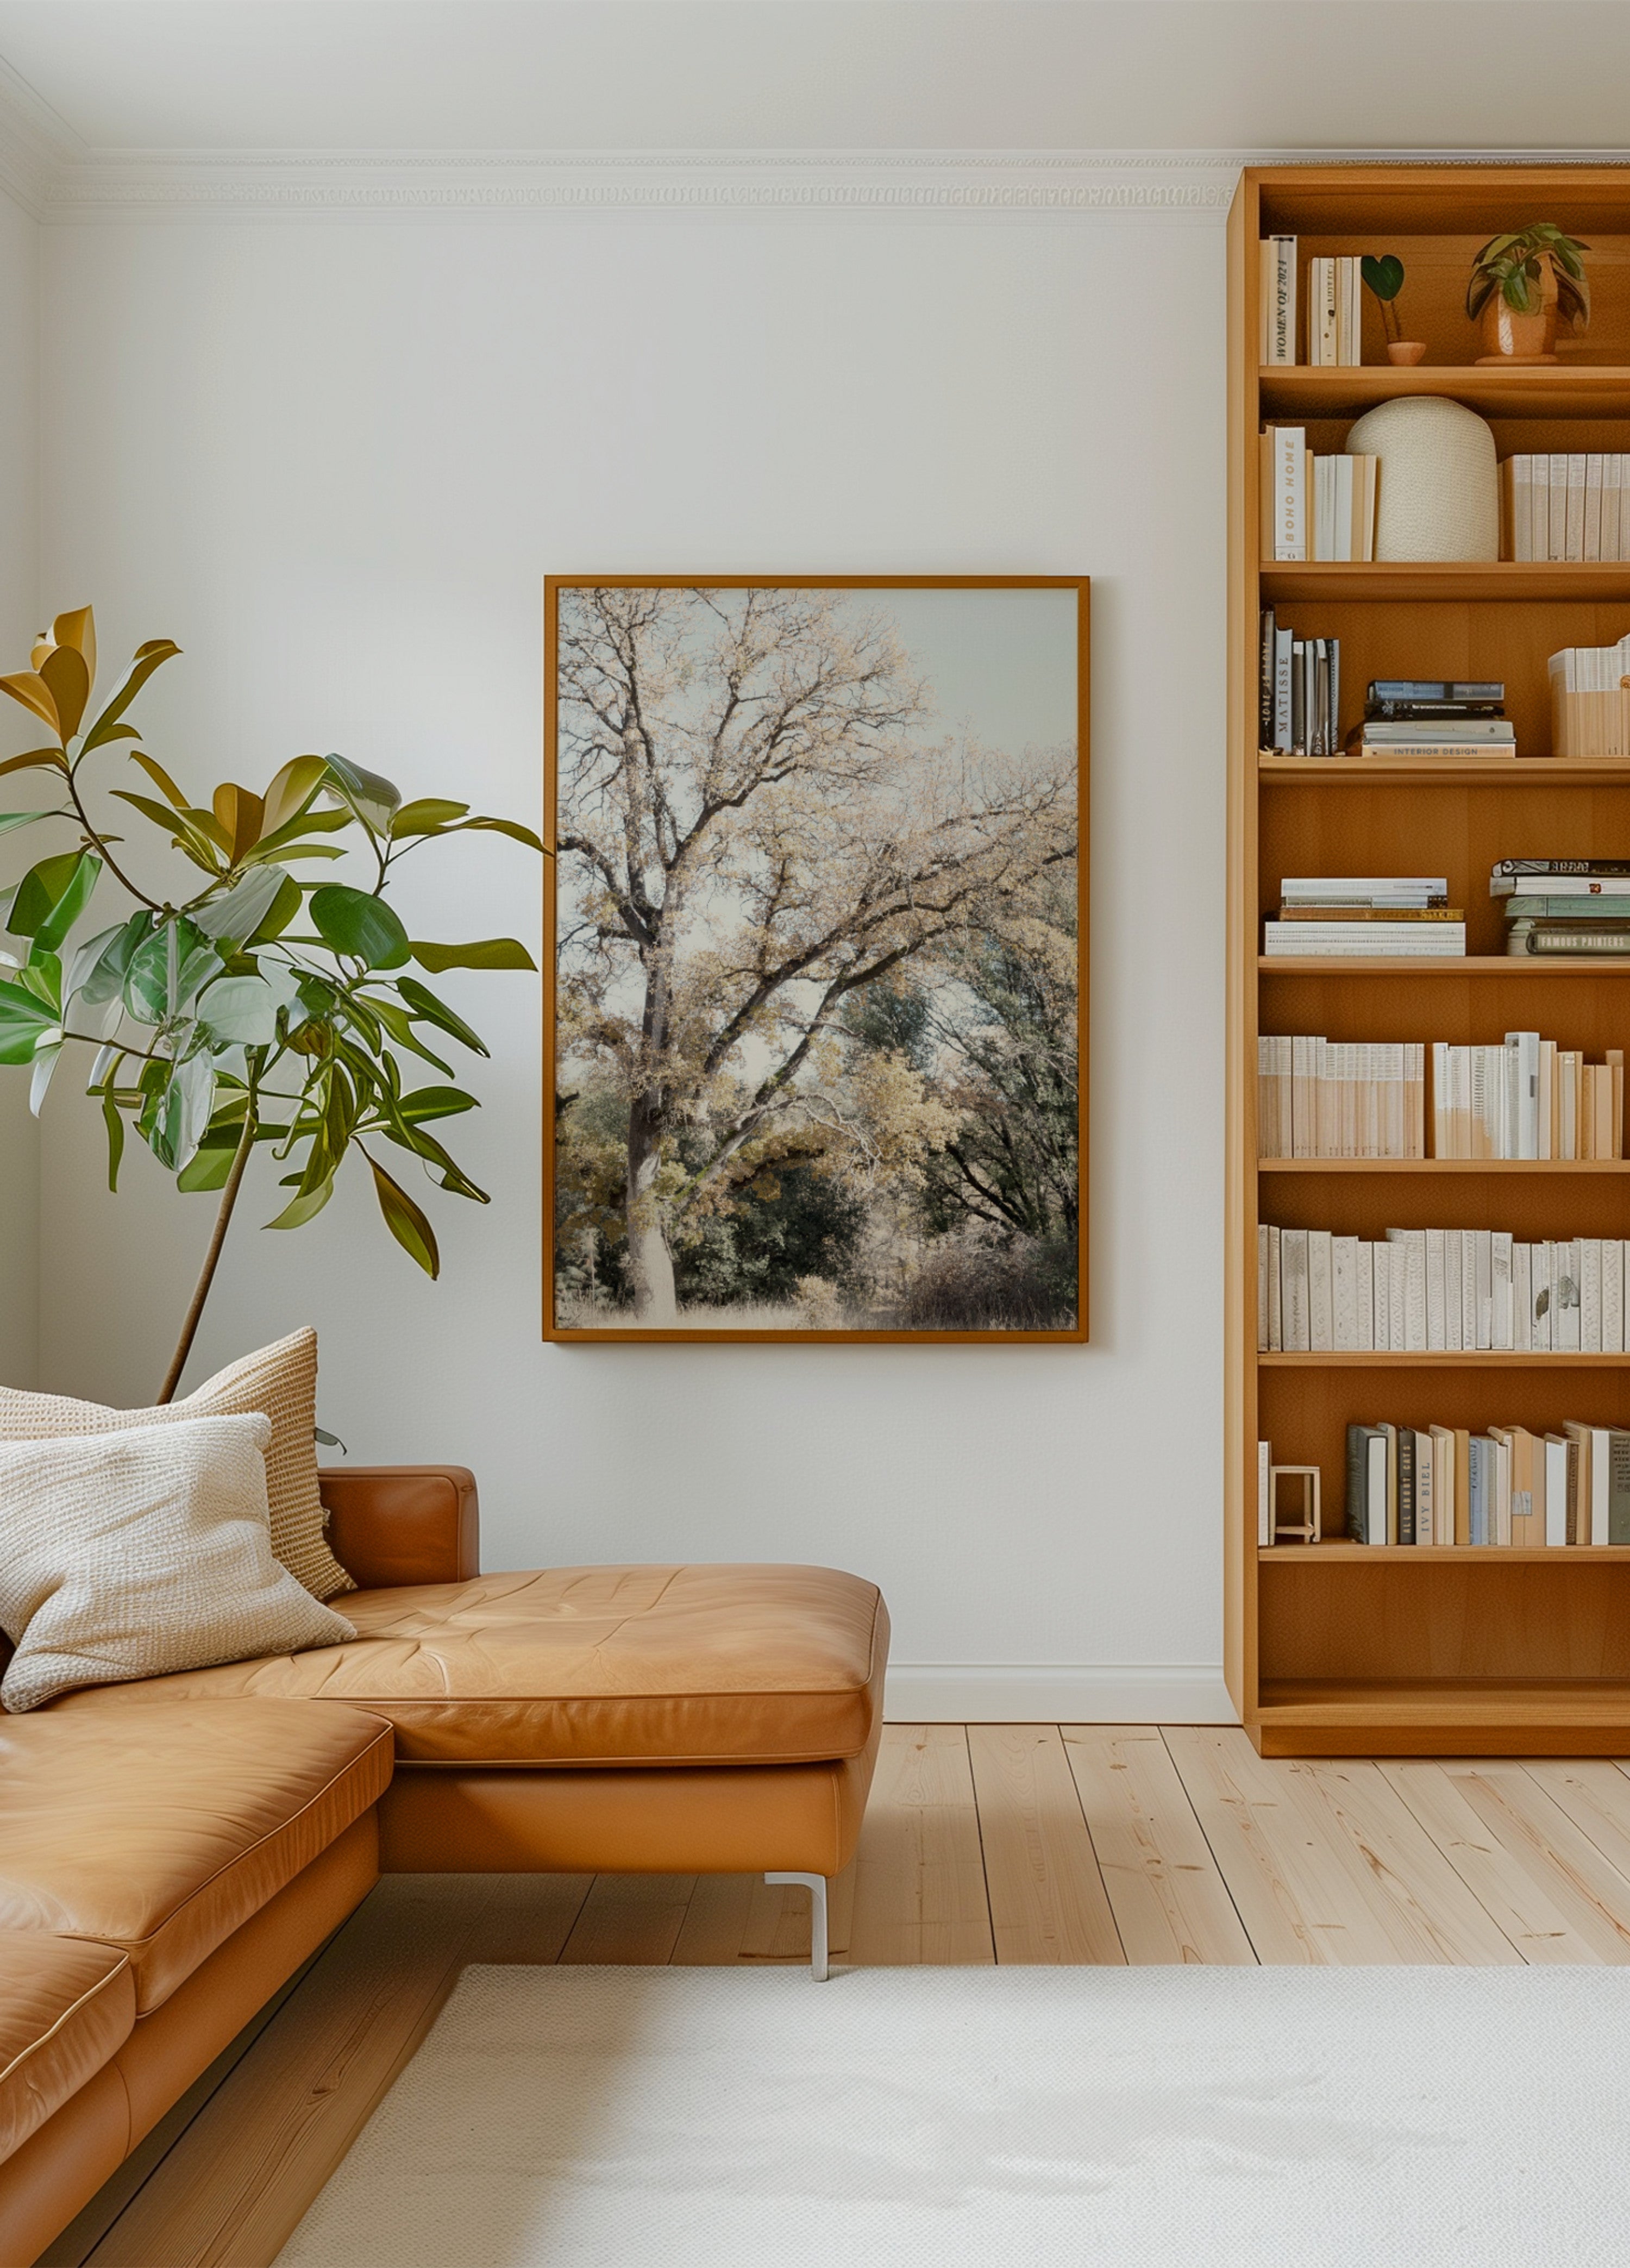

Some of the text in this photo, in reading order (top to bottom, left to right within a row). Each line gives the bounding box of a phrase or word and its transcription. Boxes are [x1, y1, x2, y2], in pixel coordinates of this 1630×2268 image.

[1277, 260, 1287, 358] WOMEN OF 2024
[1286, 441, 1294, 542] BOHO HOME
[1262, 694, 1271, 721] LOVE
[1278, 657, 1288, 732] MATISSE
[1541, 937, 1625, 947] FAMOUS PAINTERS
[1403, 1445, 1411, 1533] ALL ABOUT CATS
[1421, 1463, 1430, 1531] IVY BIEL
